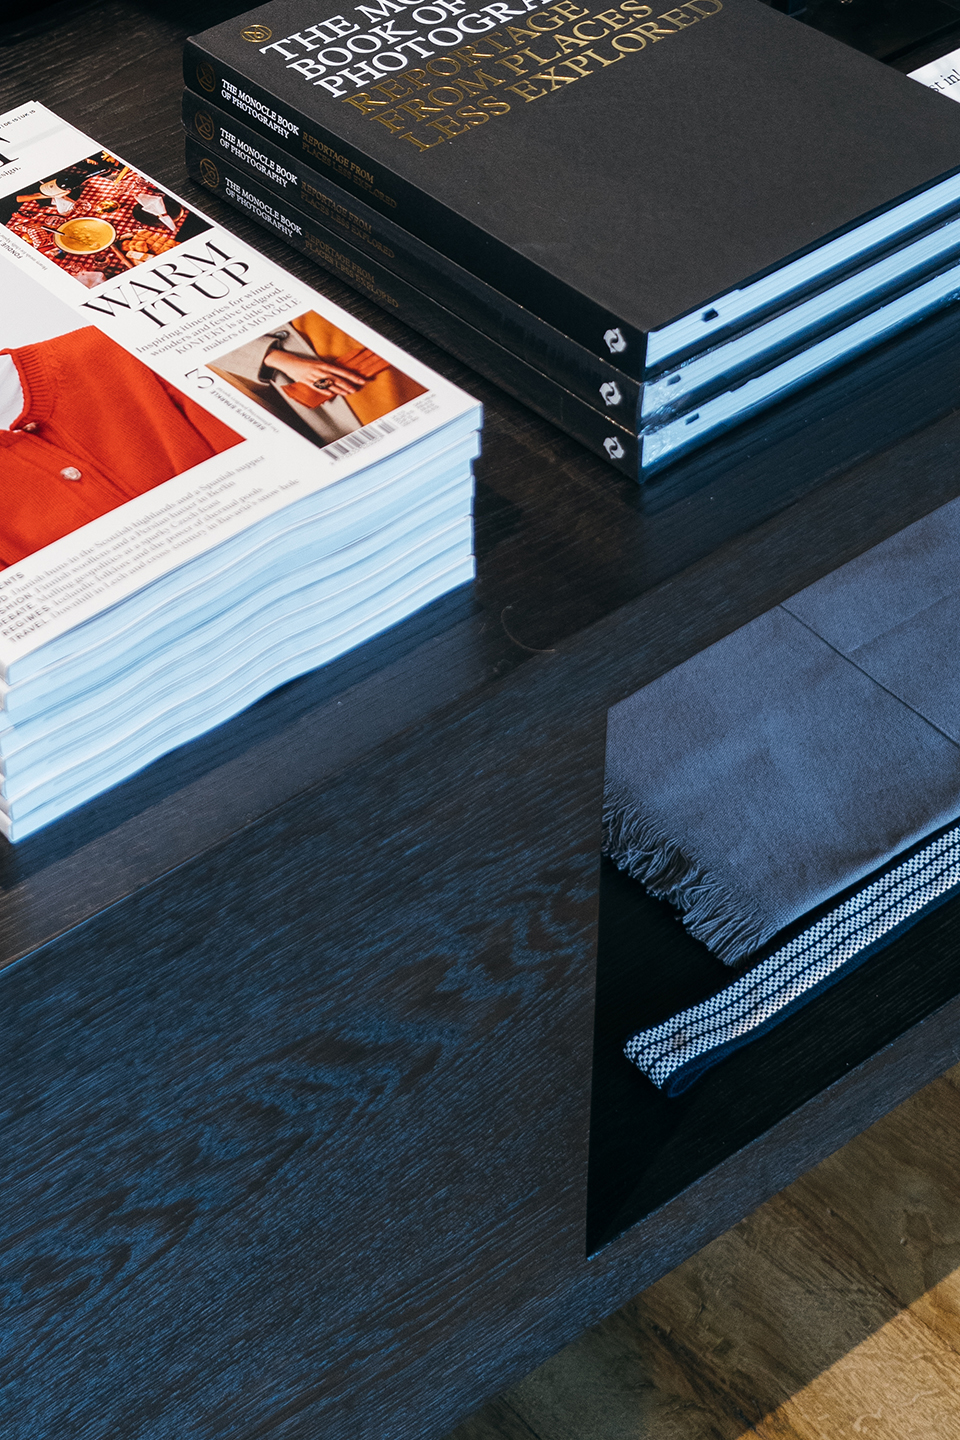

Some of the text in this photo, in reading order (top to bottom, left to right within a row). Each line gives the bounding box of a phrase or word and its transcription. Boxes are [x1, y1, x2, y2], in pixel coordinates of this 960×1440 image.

[259, 15, 360, 61] THE
[286, 21, 417, 82] BOOK
[341, 0, 589, 116] REPORTAGE
[370, 0, 655, 134] FROM PLACES
[221, 77, 299, 138] THE MONOCLE BOOK
[221, 87, 289, 144] OF PHOTOGRAPHY
[400, 95, 512, 152] LESS
[220, 126, 297, 187] THE MONOCLE BOOK
[220, 136, 287, 193] OF PHOTOGRAPHY
[302, 127, 373, 186] REPORTAGE FROM
[225, 176, 302, 237] THE MONOCLE BOOK
[225, 185, 292, 241] OF PHOTOGRAPHY
[80, 239, 236, 318] WARM
[137, 261, 251, 328] IT UP
[135, 280, 276, 353] Inspiring itineraries for winter
[148, 286, 285, 356] wonders and festive feelgood.
[174, 326, 228, 354] KONFEKT
[223, 320, 238, 329] is
[241, 307, 264, 320] title
[260, 301, 278, 311] by
[273, 292, 293, 303] the
[200, 298, 302, 351] makers of MONOCLE
[184, 367, 215, 390] 3
